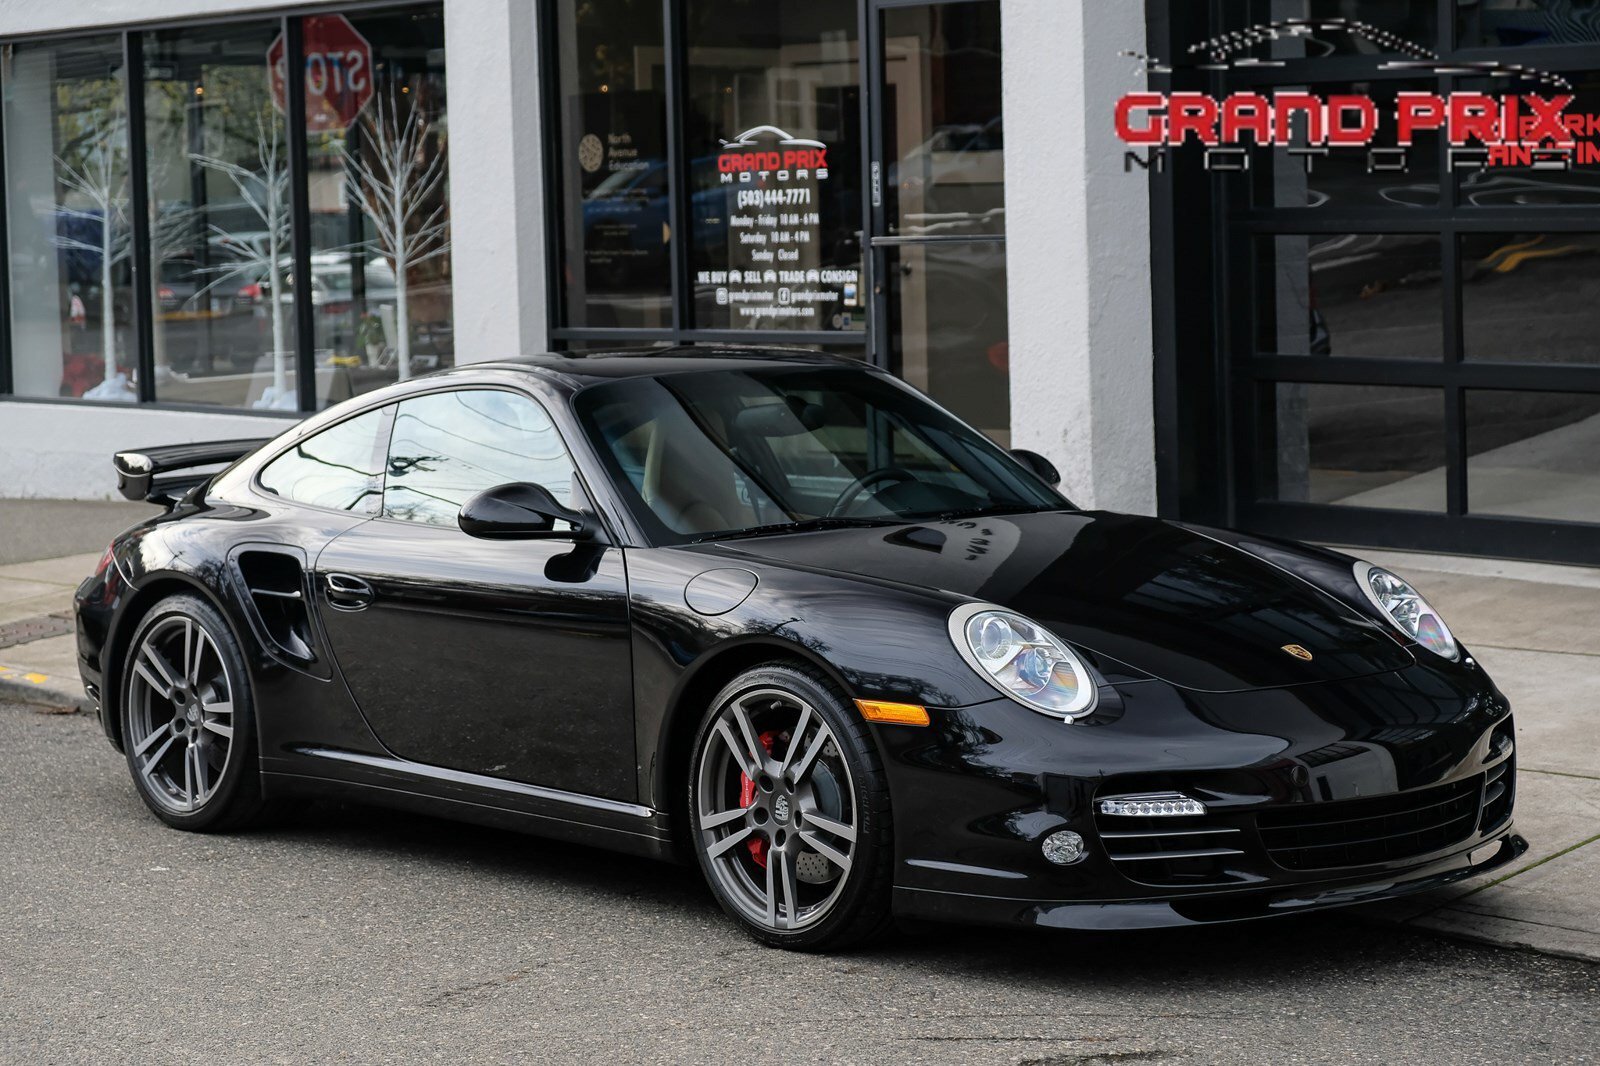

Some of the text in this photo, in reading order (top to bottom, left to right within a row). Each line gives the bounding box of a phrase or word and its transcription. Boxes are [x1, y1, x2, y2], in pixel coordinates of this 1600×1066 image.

[718, 149, 828, 172] GRAND PRIX
[720, 168, 829, 184] MOTORS
[730, 214, 754, 229] Monday
[758, 213, 778, 228] Friday
[780, 212, 789, 226] 10
[740, 231, 766, 246] Saturday
[751, 248, 799, 263] Sunday Closed
[697, 270, 857, 283] WE BUY SELL TRADE CONSIGN
